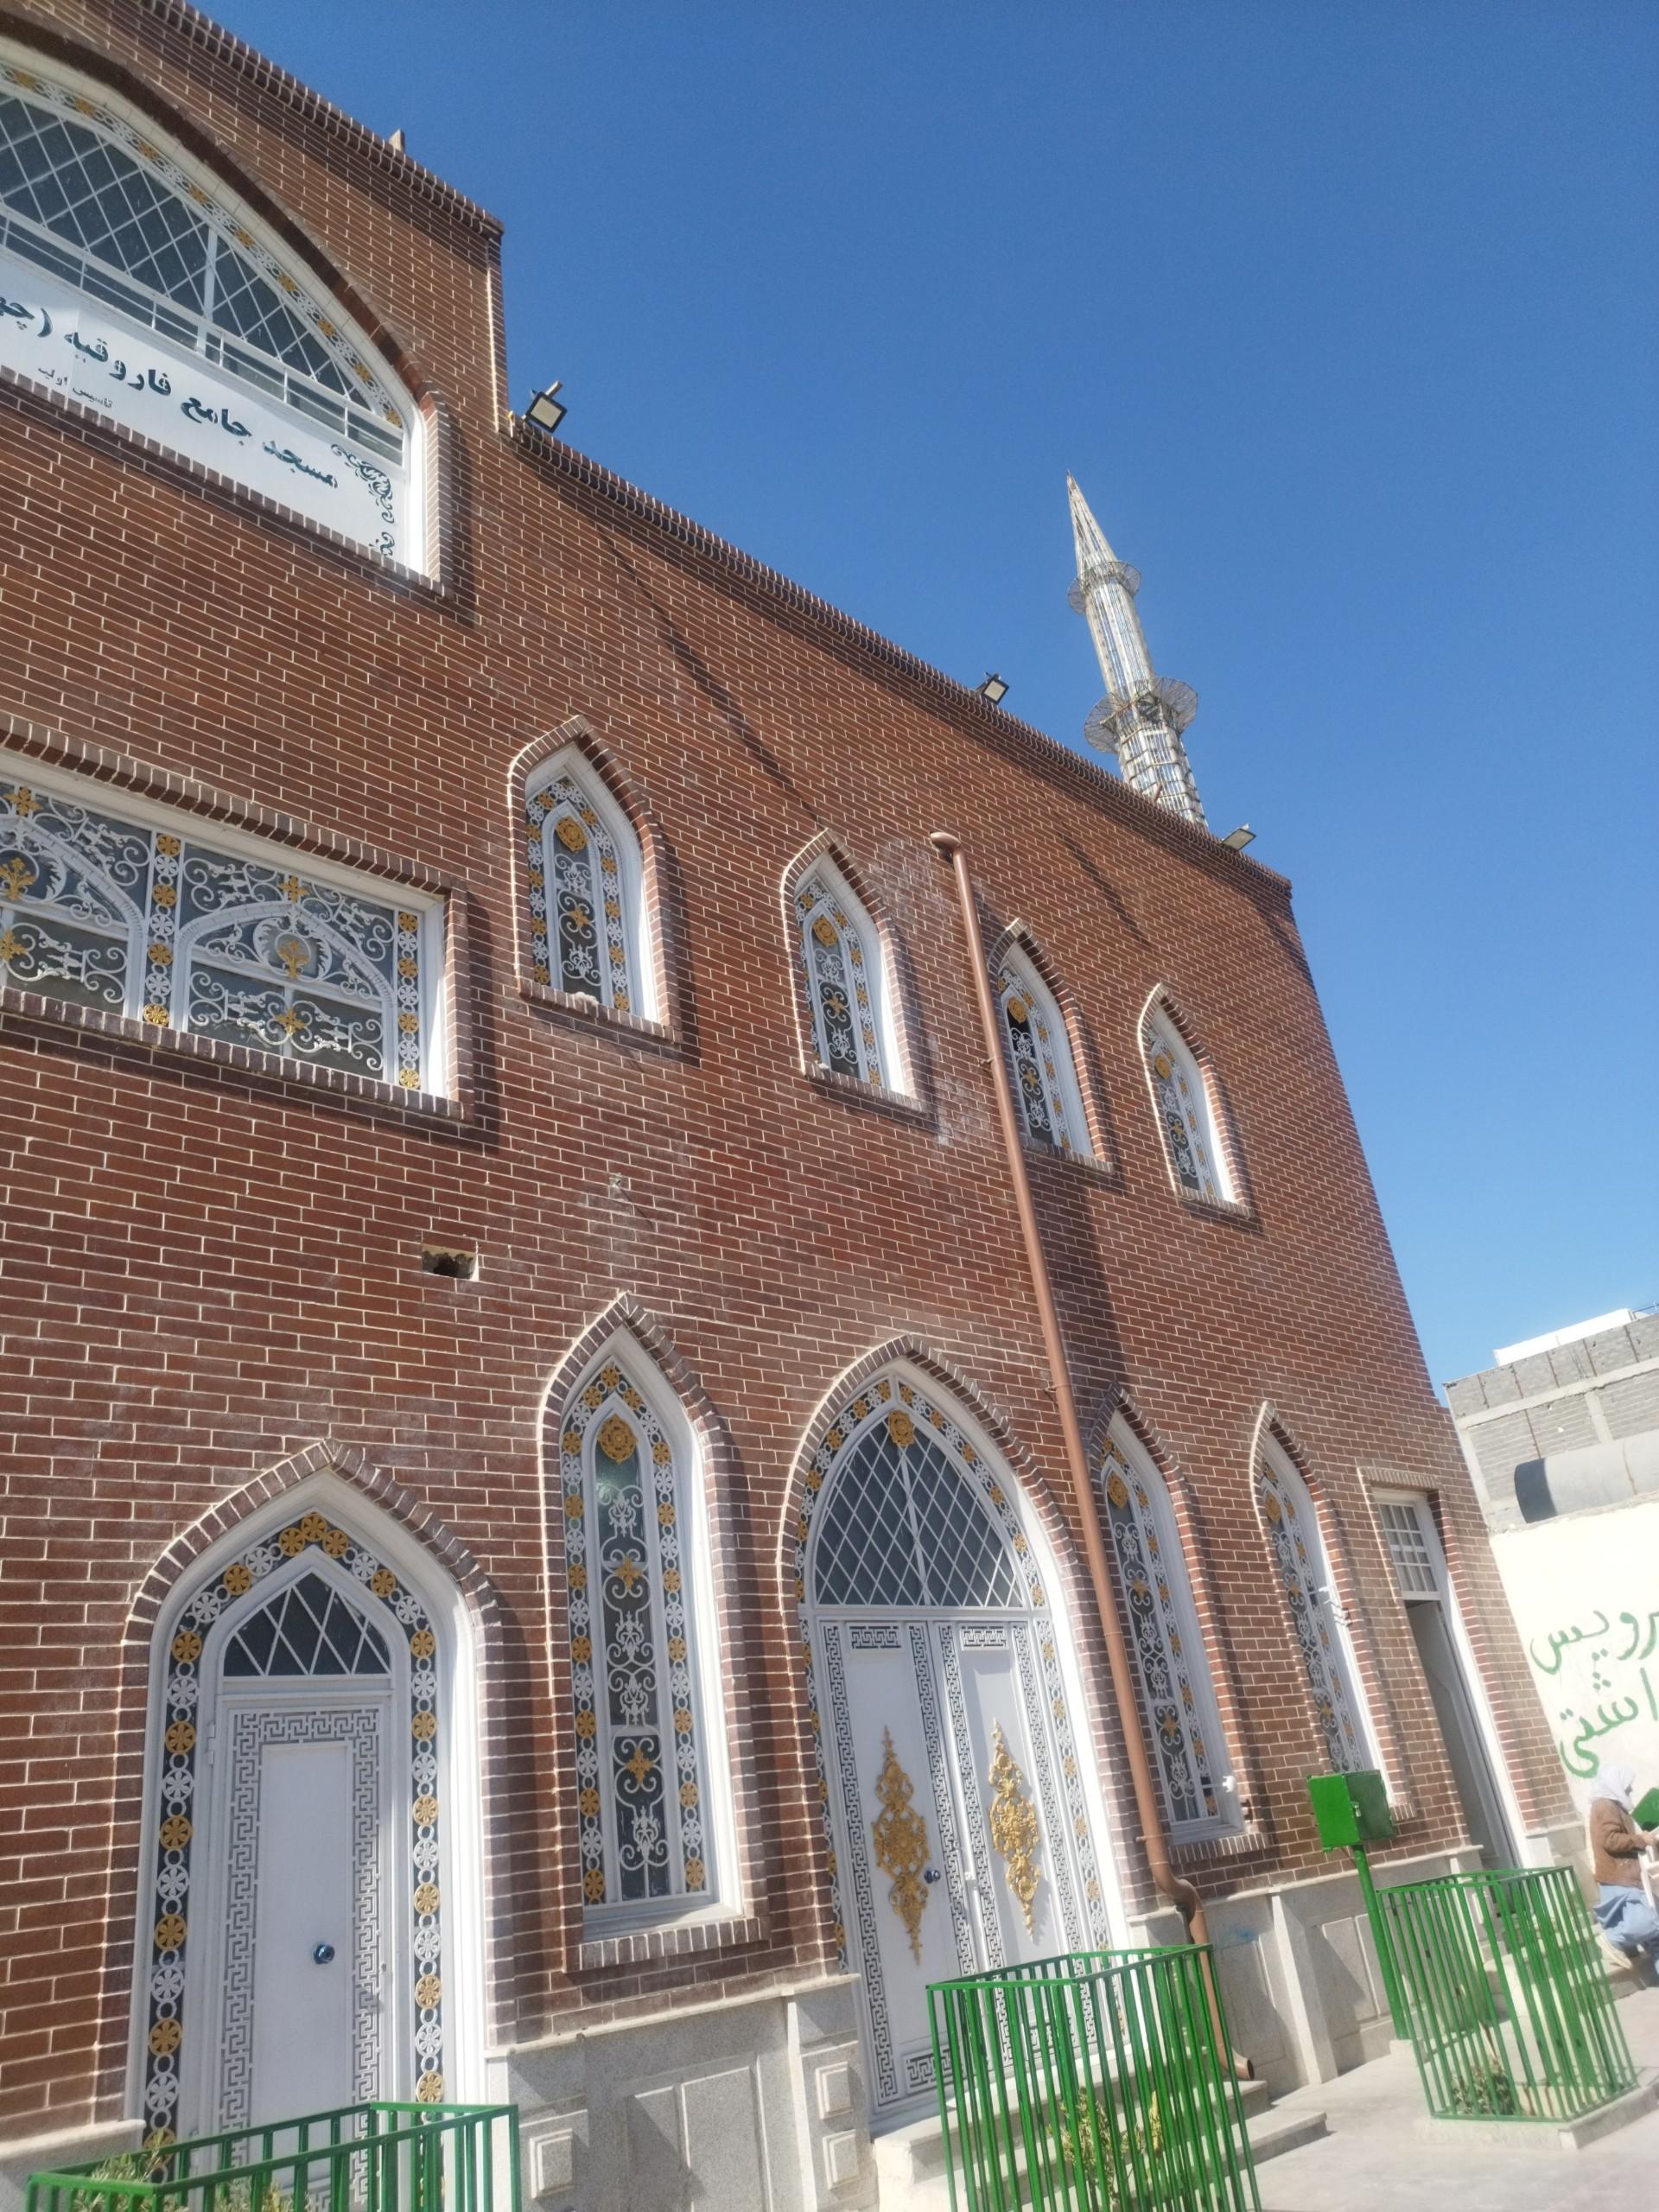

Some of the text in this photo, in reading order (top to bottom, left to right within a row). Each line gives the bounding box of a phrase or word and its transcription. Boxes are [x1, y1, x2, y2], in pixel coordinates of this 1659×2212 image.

[63, 331, 172, 397] فاروقیه
[180, 397, 253, 447] جامع
[262, 440, 339, 489] مسجد
[1530, 1610, 1659, 1675] رویس
[1559, 1667, 1659, 1779] اشتی
